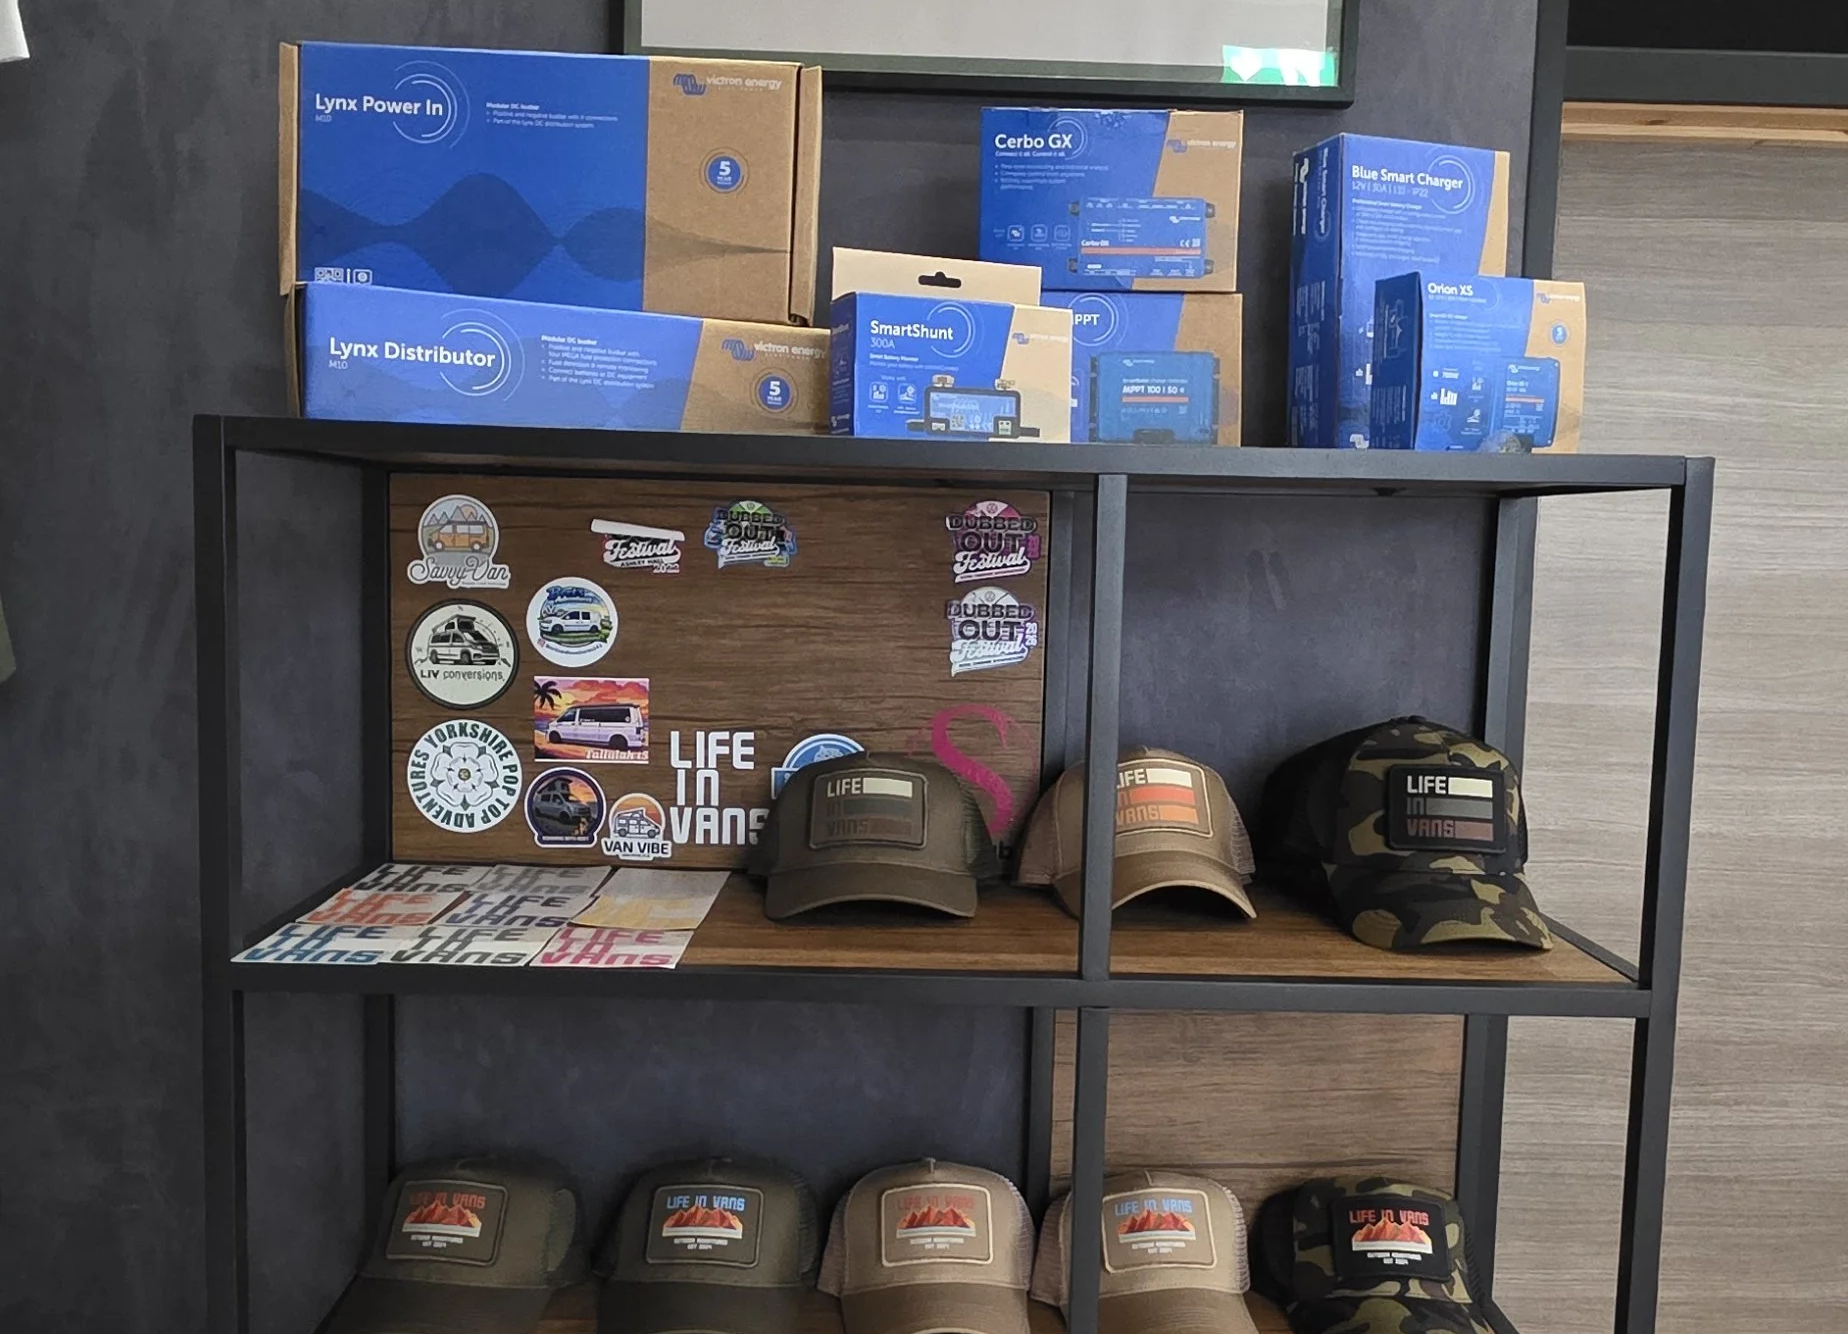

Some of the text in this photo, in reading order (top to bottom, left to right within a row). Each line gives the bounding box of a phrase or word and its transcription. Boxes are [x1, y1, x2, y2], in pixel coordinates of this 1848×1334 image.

[707, 75, 782, 90] victron energy
[315, 94, 443, 116] Lynx Power In
[995, 134, 1073, 149] Cerbo GX
[719, 161, 731, 176] 5
[1352, 165, 1463, 190] Blue Smart Charger
[1428, 283, 1474, 296] Orion XS
[1073, 313, 1100, 325] PPT
[870, 320, 953, 340] SmartShunt
[754, 342, 826, 359] victron energy
[870, 337, 895, 349] 300A
[329, 336, 496, 368] Lynx Distributor
[769, 381, 781, 396] 5
[949, 515, 1035, 532] DUBBED
[603, 539, 677, 560] Festival
[960, 531, 1025, 553] OUT
[953, 547, 1026, 574] Festival
[948, 603, 1033, 619] DUBBED
[958, 620, 1021, 641] OUT
[950, 634, 1024, 661] Festival
[421, 669, 440, 679] LIV
[670, 731, 754, 770] LIFE
[410, 722, 519, 828] YORKSHIRE POP TOP ADVENTURES
[677, 769, 719, 806] IN
[827, 777, 861, 798] LIFE
[1407, 775, 1447, 794] LIFE
[1406, 797, 1424, 815] IN
[669, 807, 769, 845] VANS
[1407, 818, 1454, 838] VANS
[604, 841, 669, 855] VAN VIBE
[378, 864, 470, 875] LIFE
[353, 881, 468, 893] VANS
[337, 888, 435, 904] LIFE
[471, 893, 570, 907] LIFE
[307, 911, 432, 924] VANS
[446, 913, 570, 927] VANS
[278, 925, 393, 939] LIFE
[419, 927, 528, 941] LIFE
[558, 928, 665, 944] LIFE
[244, 948, 384, 963] VANS
[390, 950, 528, 965] VANS
[539, 952, 674, 965] VANS
[453, 1193, 486, 1209] VANS
[667, 1195, 745, 1211] LIFE IN VANS
[1115, 1198, 1192, 1216] LIFE IN VANS
[1349, 1209, 1429, 1226] LIFE IN VANS
